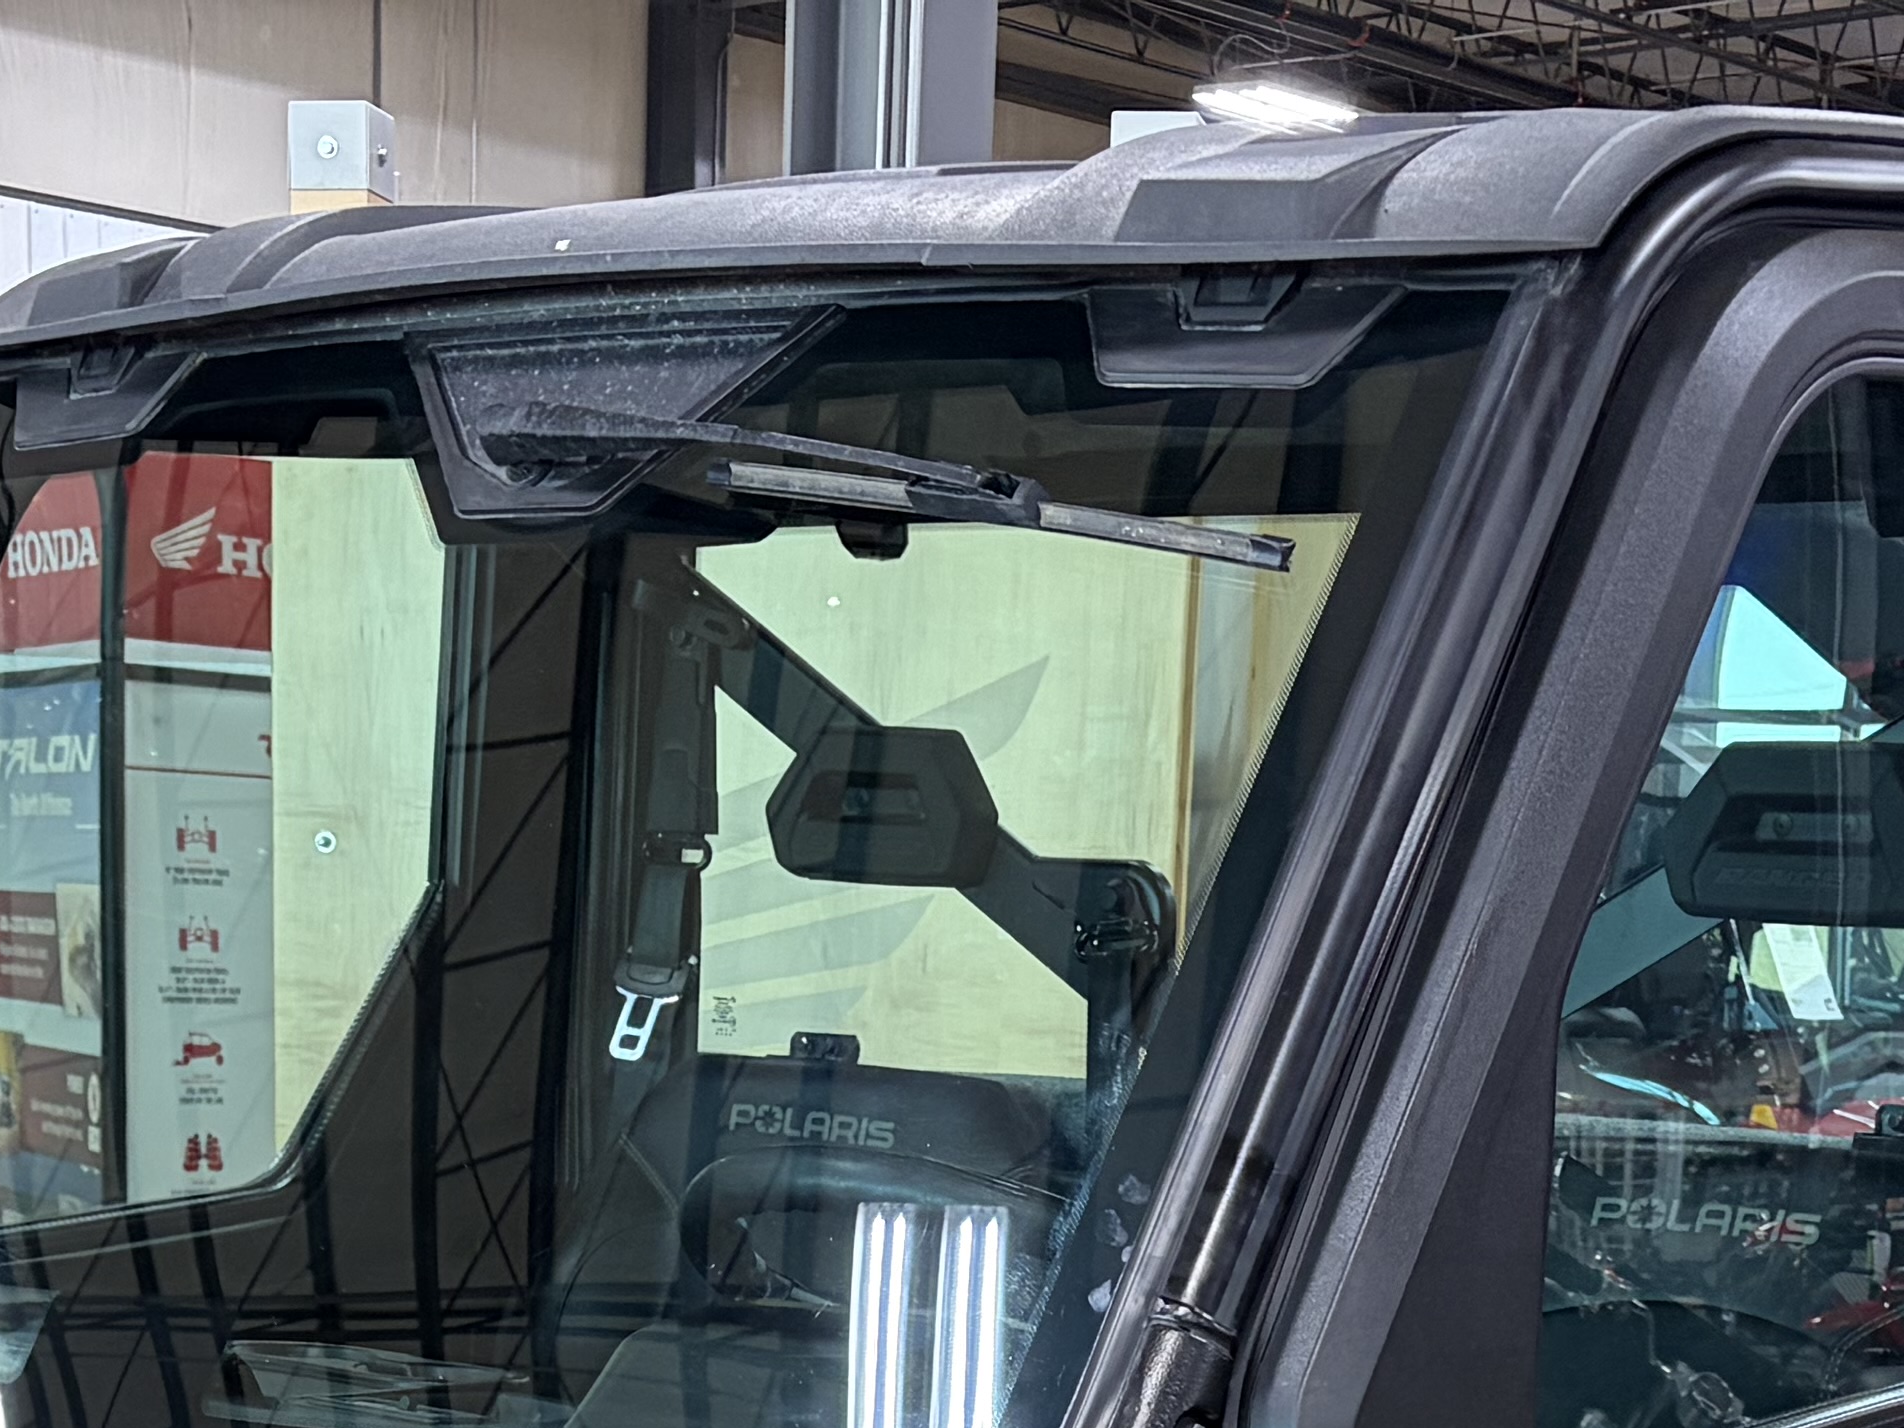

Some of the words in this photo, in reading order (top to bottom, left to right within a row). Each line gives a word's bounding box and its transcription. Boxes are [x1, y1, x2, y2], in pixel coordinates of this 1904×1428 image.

[7, 526, 99, 579] HONDA
[217, 533, 272, 578] H
[729, 1103, 895, 1149] POLARIS
[1590, 1197, 1822, 1245] POLARIS
